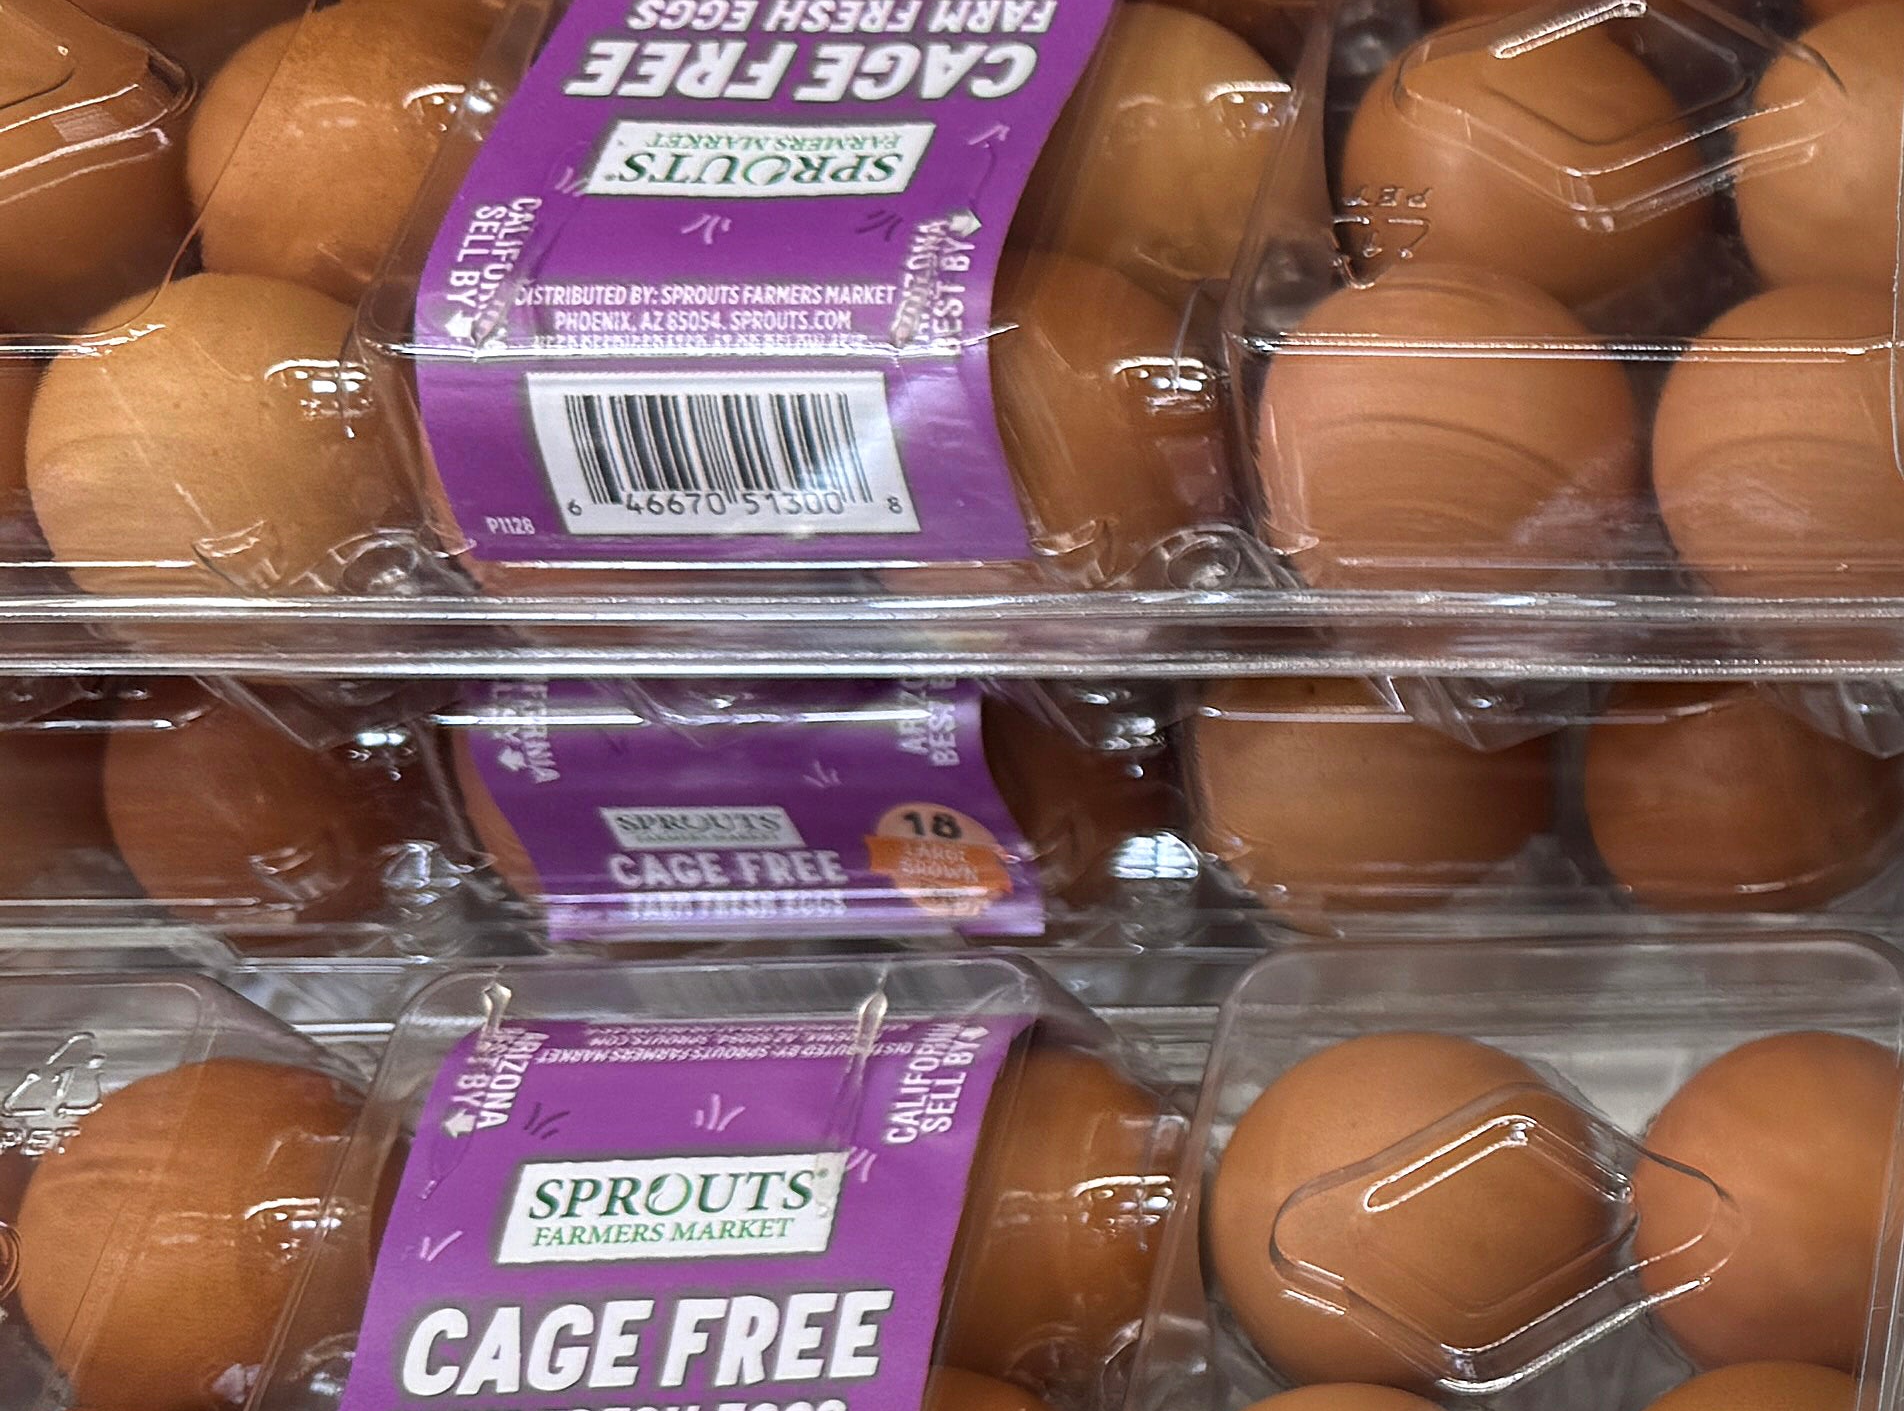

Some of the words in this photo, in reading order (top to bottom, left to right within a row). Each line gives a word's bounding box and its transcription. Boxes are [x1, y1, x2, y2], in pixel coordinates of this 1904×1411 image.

[565, 42, 790, 99] FREE
[795, 42, 1039, 100] CAGE
[647, 133, 775, 148] MARKET
[782, 135, 903, 150] FARMERS
[630, 285, 658, 304] BY:
[660, 285, 740, 305] SPROUTS
[742, 285, 822, 305] FARMERS
[826, 284, 896, 305] MARKET
[641, 312, 663, 330] AZ
[625, 493, 725, 514] 46670
[486, 516, 536, 535] P1128
[903, 813, 961, 839] 18
[607, 852, 730, 887] CAGE
[735, 850, 848, 884] FREE
[533, 1224, 666, 1247] FARMERS
[671, 1218, 794, 1241] MARKET
[402, 1300, 656, 1396] CAGE
[664, 1289, 894, 1385] FREE
